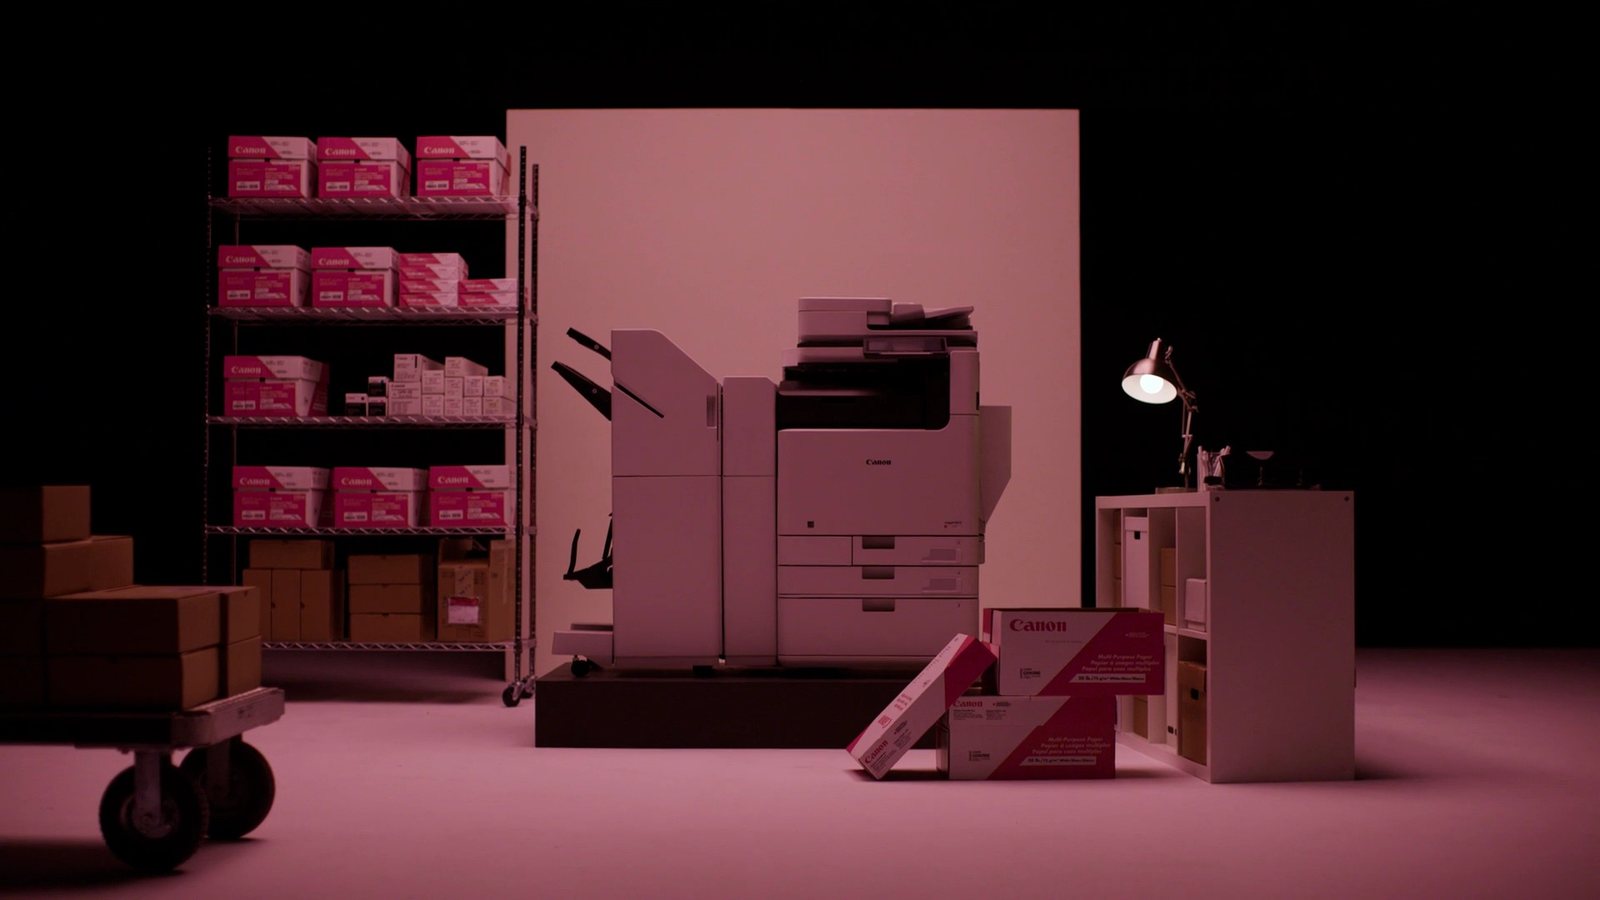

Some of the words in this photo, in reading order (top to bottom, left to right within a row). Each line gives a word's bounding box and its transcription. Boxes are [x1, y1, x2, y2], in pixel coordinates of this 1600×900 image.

[235, 145, 266, 154] Canon
[324, 147, 356, 156] Canon
[423, 145, 455, 154] Canon
[225, 254, 256, 264] Canon
[318, 257, 349, 266] Canon
[231, 365, 261, 374] Canon
[239, 476, 271, 485] Canon
[341, 477, 372, 486] Canon
[437, 475, 469, 484] Canon
[1010, 619, 1066, 631] Canon
[1135, 653, 1153, 661] Paper
[953, 700, 983, 708] Canon
[864, 740, 889, 764] Canon
